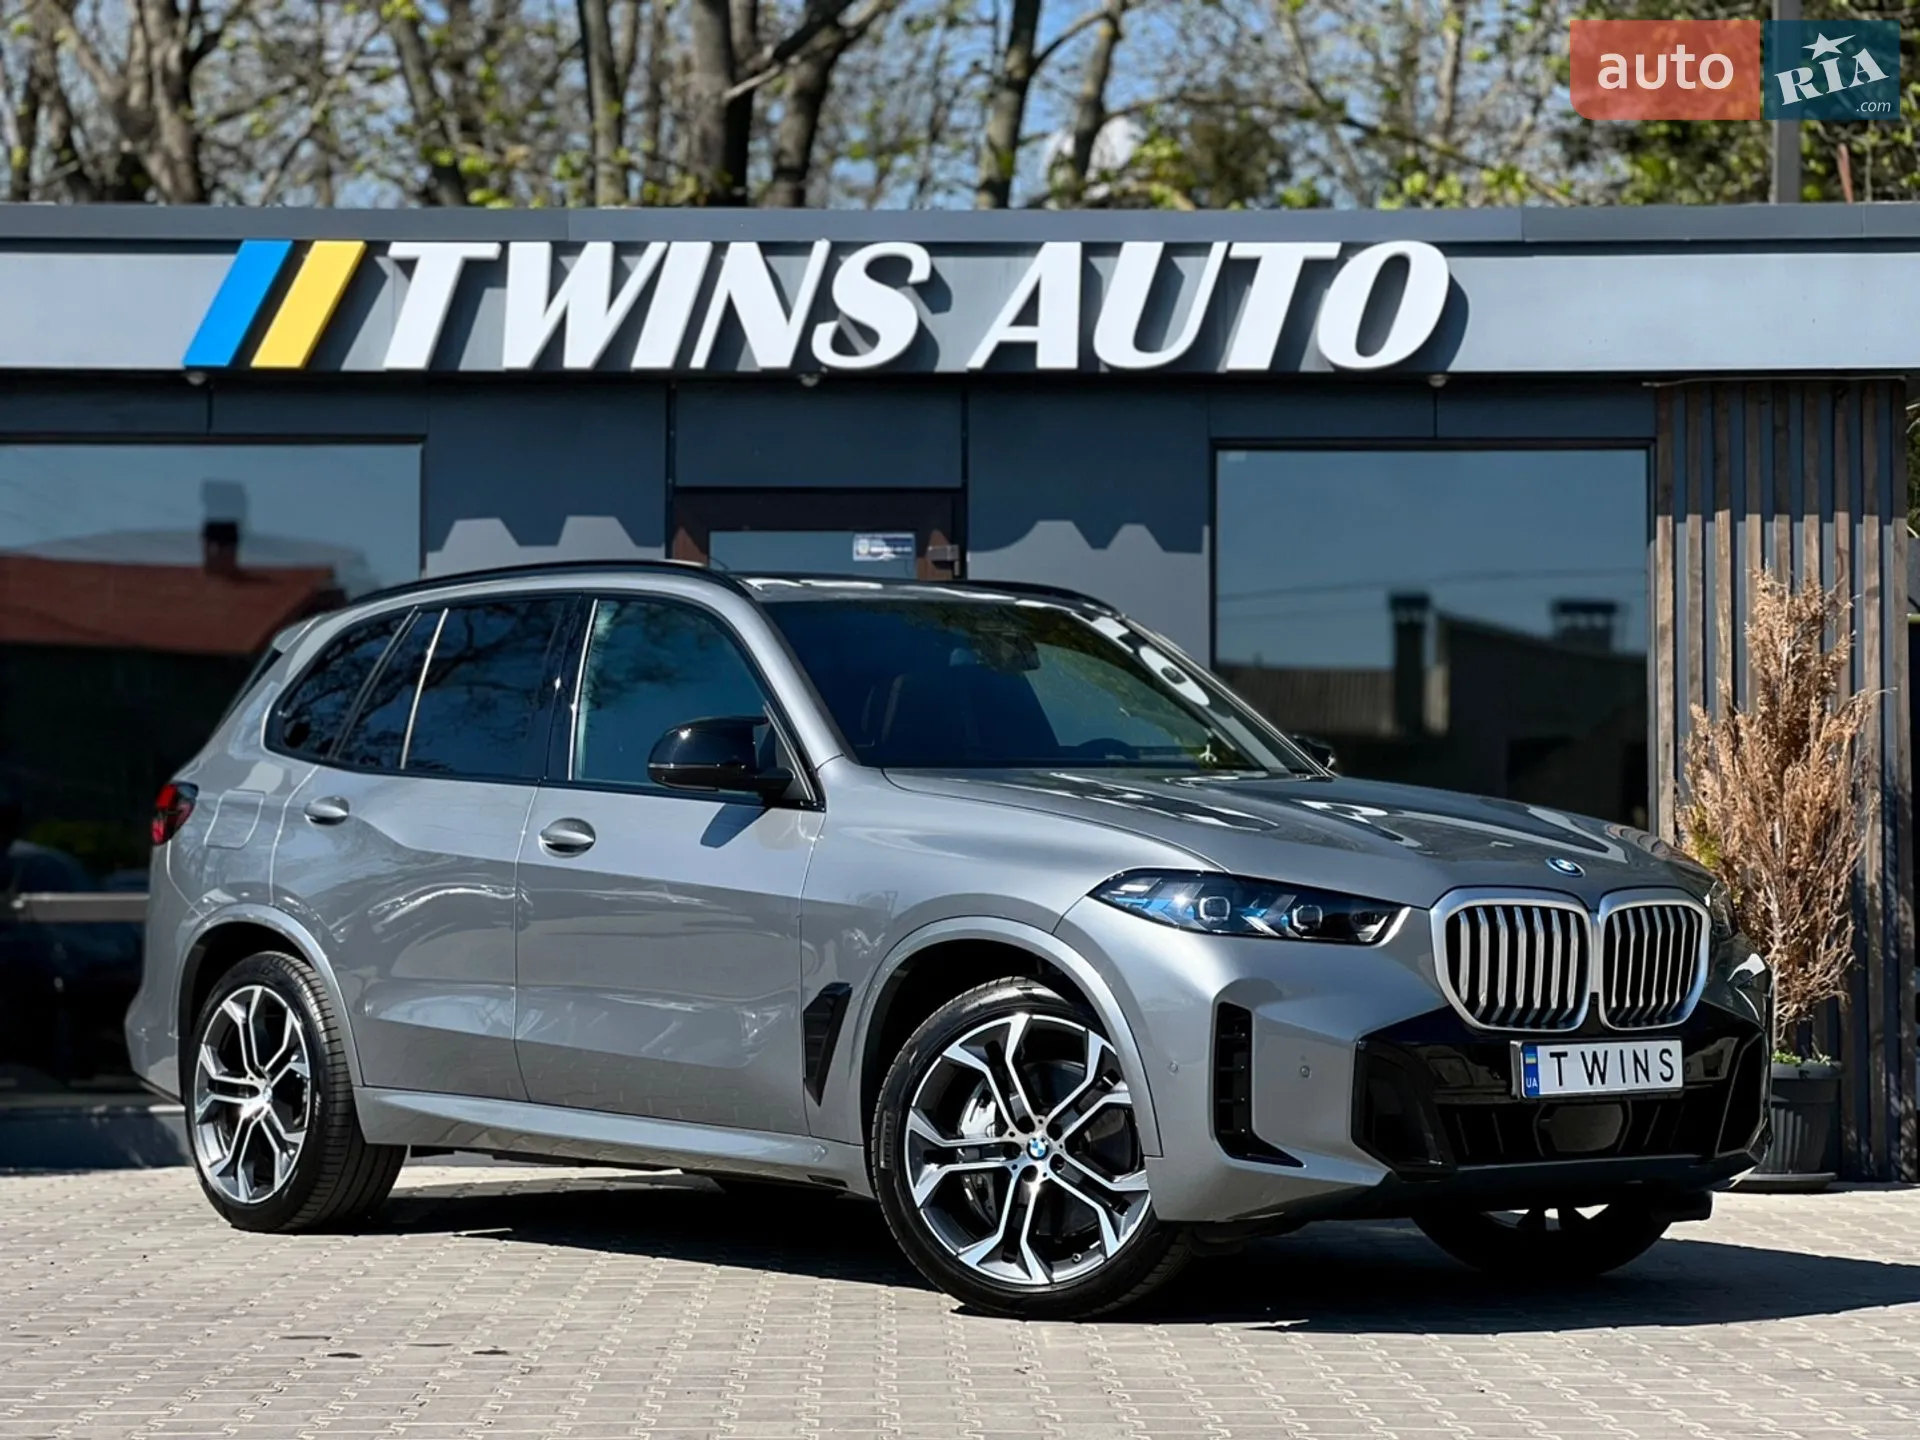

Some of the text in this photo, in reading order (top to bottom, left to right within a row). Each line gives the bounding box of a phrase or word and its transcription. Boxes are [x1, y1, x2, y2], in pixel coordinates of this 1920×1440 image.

[384, 240, 1450, 371] TWINS AUTO
[1525, 1048, 1674, 1088] UA TWINS
